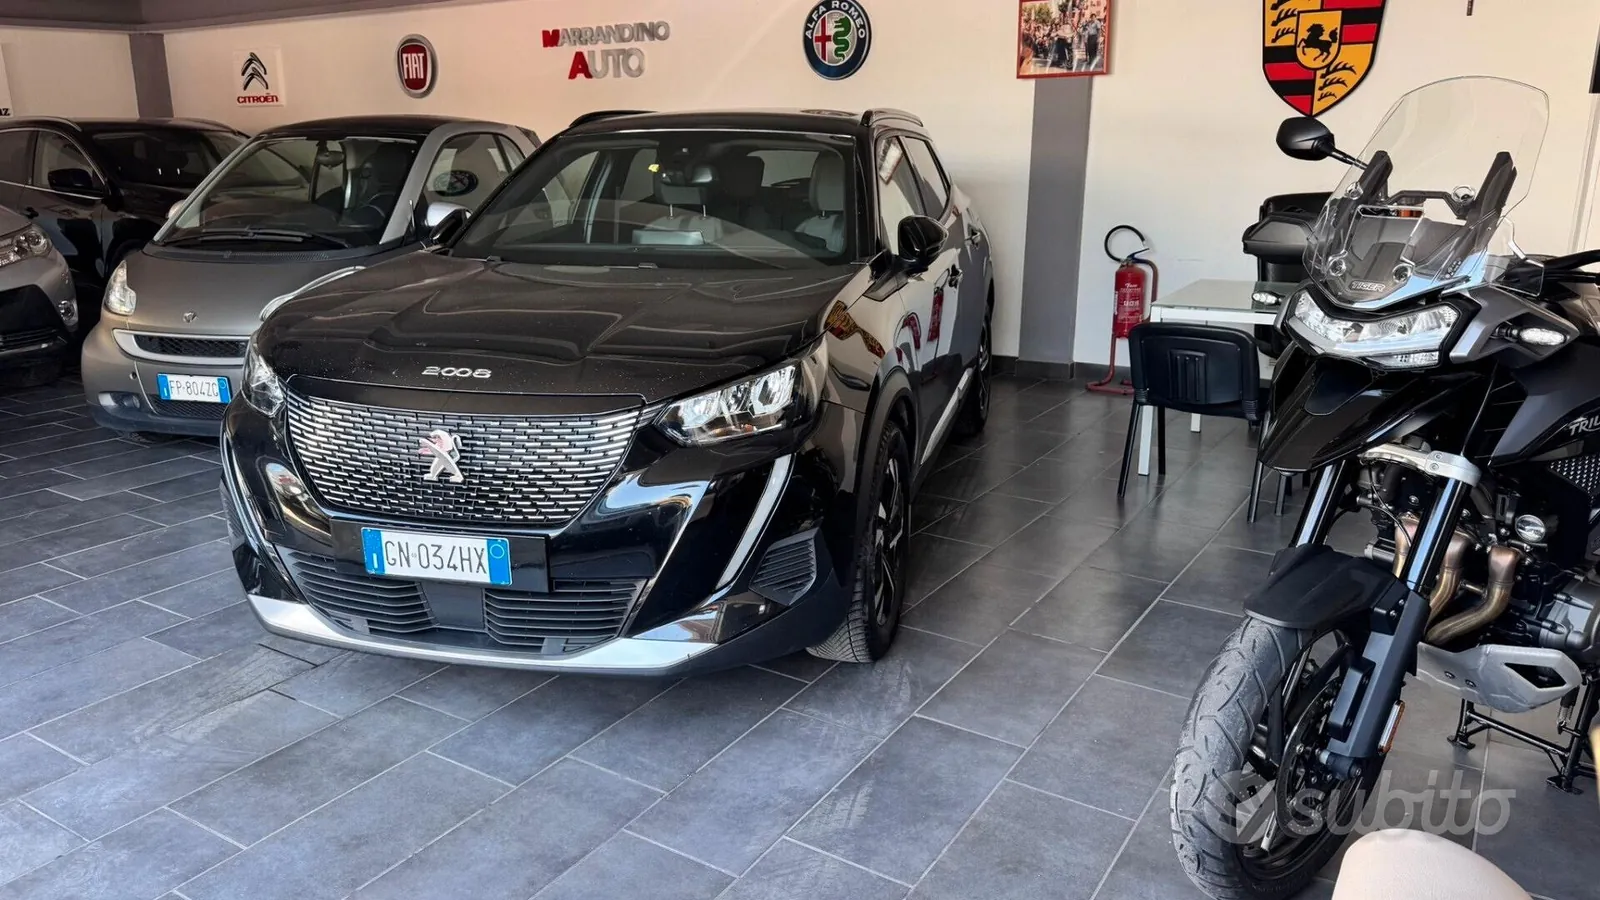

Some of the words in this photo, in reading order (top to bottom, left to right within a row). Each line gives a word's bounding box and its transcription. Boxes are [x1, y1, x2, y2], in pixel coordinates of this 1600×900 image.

[805, 5, 827, 39] ALFA
[831, 0, 866, 38] ROMEO
[541, 20, 670, 48] MARRANDINO
[402, 53, 425, 79] FIAT
[568, 47, 645, 80] AUTO
[1351, 280, 1386, 292] TIGER
[421, 366, 492, 379] 2008
